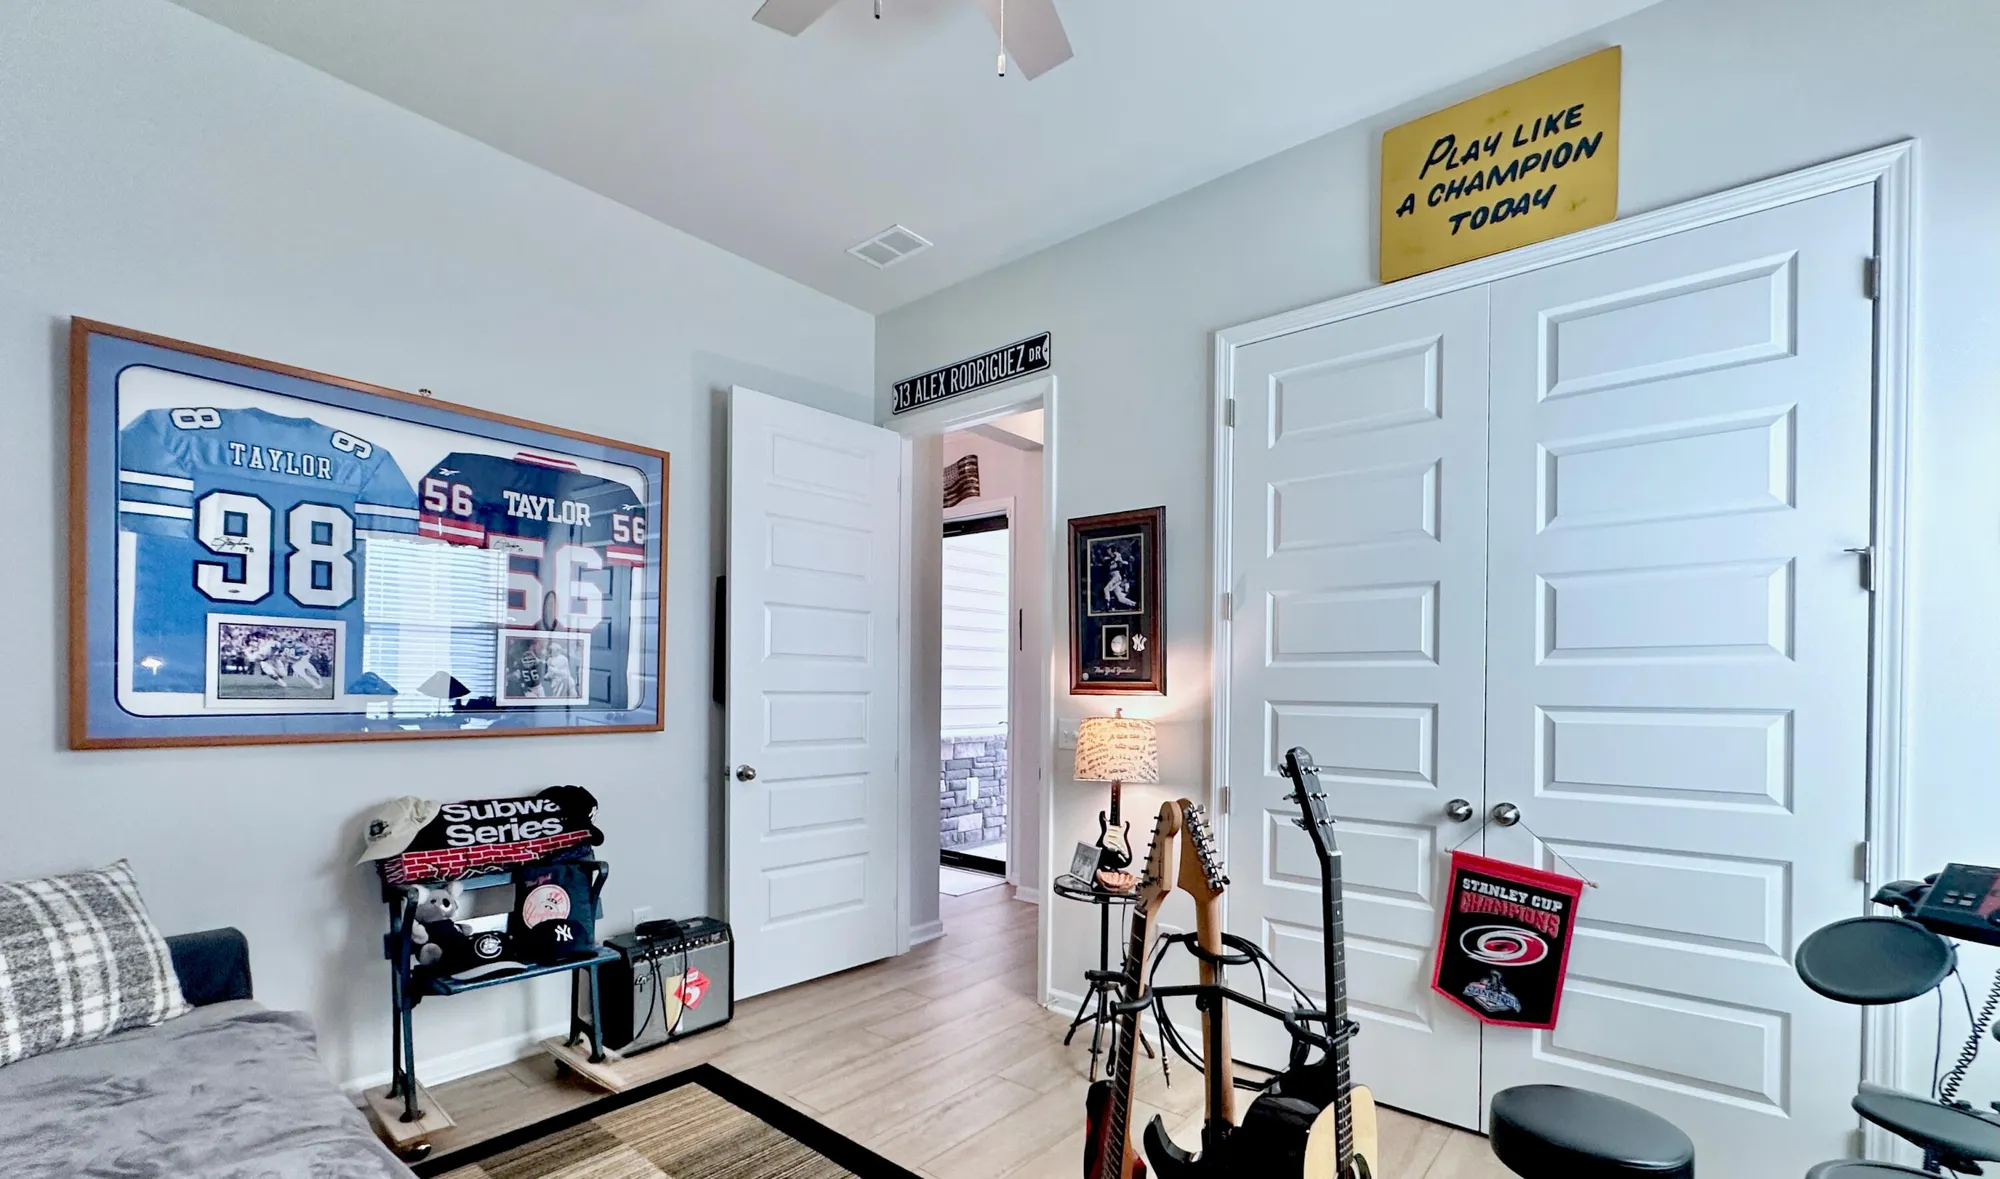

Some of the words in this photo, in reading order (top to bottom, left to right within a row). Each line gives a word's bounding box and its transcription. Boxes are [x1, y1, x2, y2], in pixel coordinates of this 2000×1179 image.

[1419, 132, 1503, 180] PLAY
[1512, 103, 1585, 149] LIKE
[1396, 193, 1416, 218] A
[1427, 131, 1604, 208] CHAMPION
[1448, 184, 1557, 236] TODAY
[899, 382, 911, 409] 13
[914, 371, 946, 404] ALEX
[950, 344, 1025, 394] RODRIGUEZ
[1028, 345, 1042, 363] DR
[228, 441, 334, 481] TAYLOR
[422, 477, 474, 517] 56
[502, 489, 592, 528] TAYLOR
[192, 488, 358, 610] 98
[612, 513, 646, 546] 56
[488, 533, 603, 632] 56
[521, 668, 540, 682] 56
[440, 798, 562, 823] Subwa
[445, 817, 564, 847] Series
[1459, 890, 1561, 939] CHAMPIONS
[1462, 878, 1529, 904] STANLEY
[1531, 895, 1563, 913] CUP
